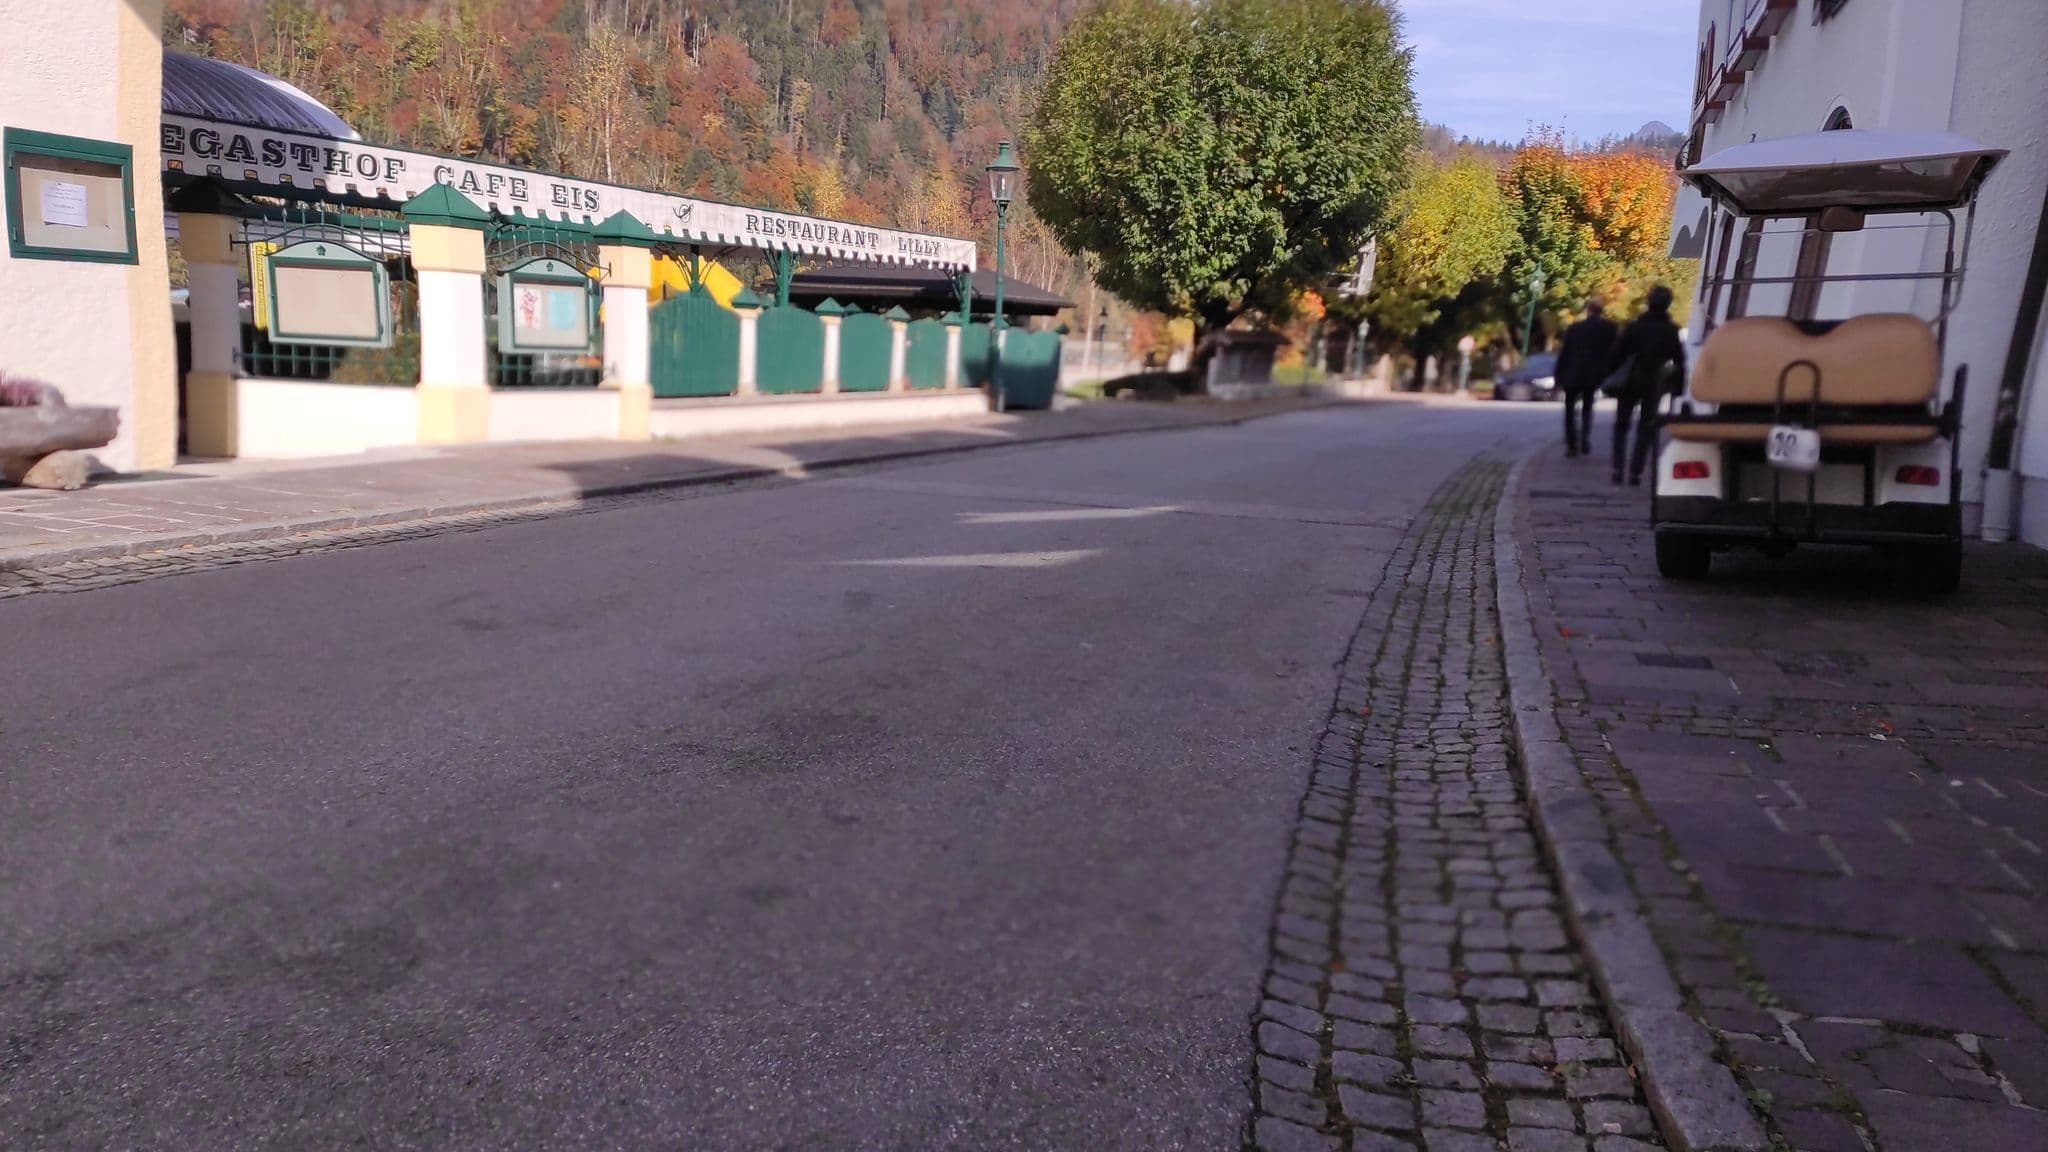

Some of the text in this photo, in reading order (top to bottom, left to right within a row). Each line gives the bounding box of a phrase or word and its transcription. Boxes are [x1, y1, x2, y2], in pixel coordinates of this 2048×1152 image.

[434, 165, 528, 202] CAFE
[550, 183, 600, 212] EIS
[746, 214, 879, 249] RESTAURANT
